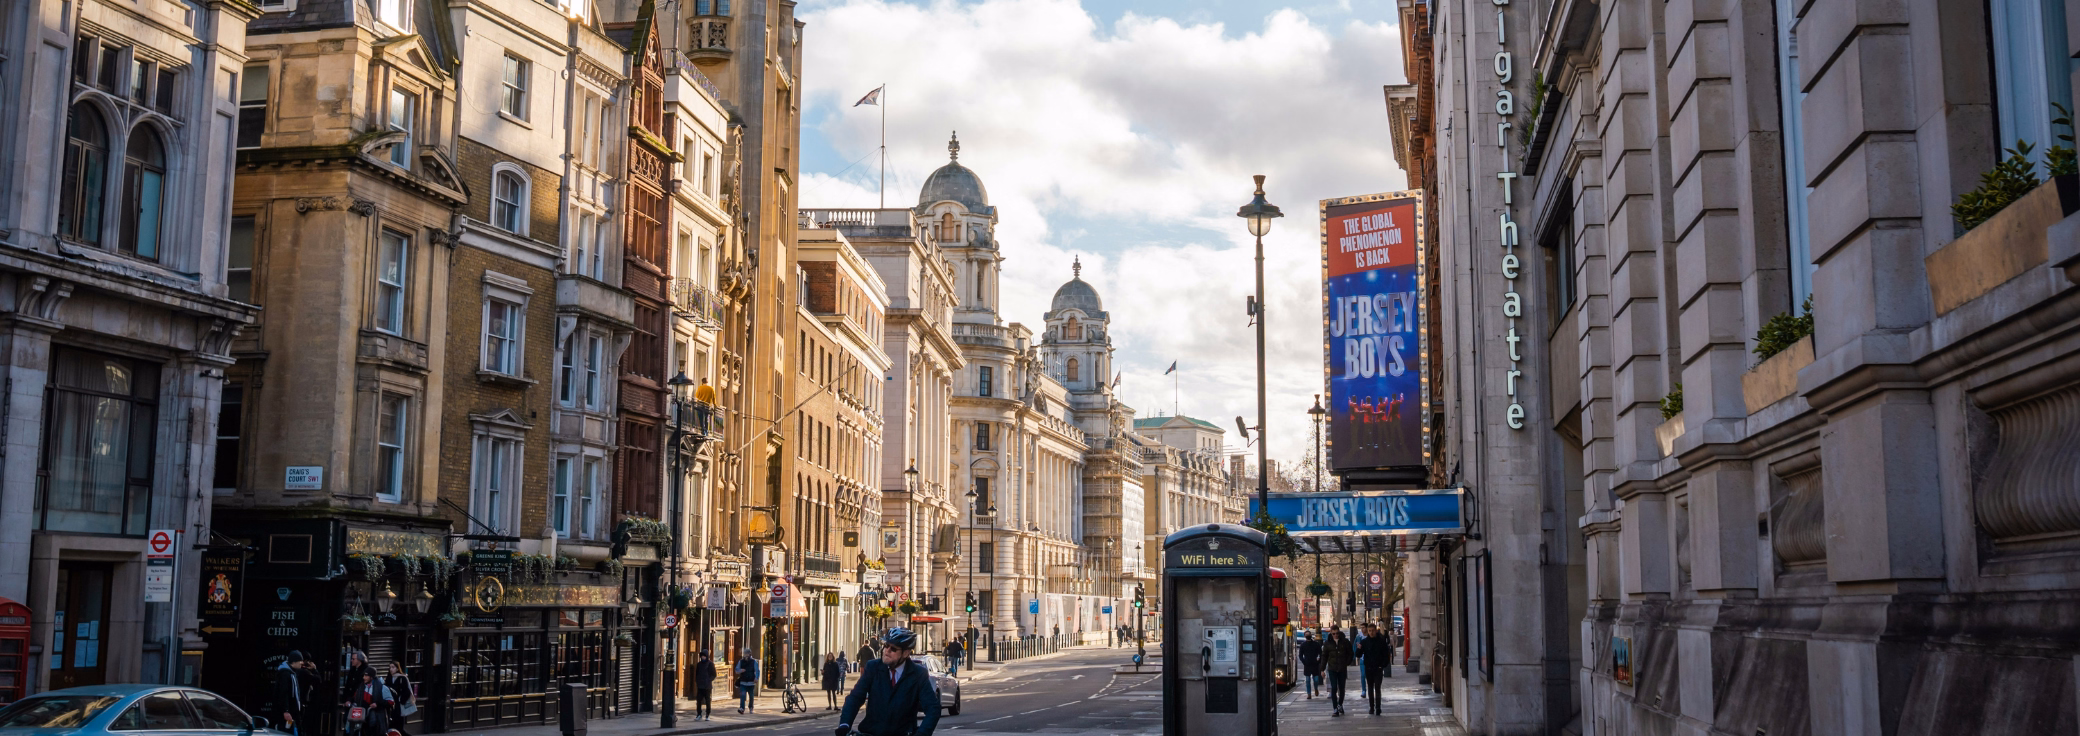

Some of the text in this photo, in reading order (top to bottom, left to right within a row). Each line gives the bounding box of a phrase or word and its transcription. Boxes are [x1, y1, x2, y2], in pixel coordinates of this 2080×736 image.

[1342, 212, 1395, 235] THE GLOBAL
[1492, 0, 1525, 430] lgar Theatre
[1340, 228, 1402, 253] PHENOMENON
[1355, 248, 1390, 268] IS BACK
[1330, 291, 1416, 338] JERSEY
[1344, 335, 1405, 380] BOYS
[1296, 497, 1409, 528] JERSEY BOYS
[1181, 555, 1234, 565] WiFi here
[272, 611, 295, 620] FISH
[267, 628, 298, 636] CHIPS
[264, 655, 289, 664] PURVEY
